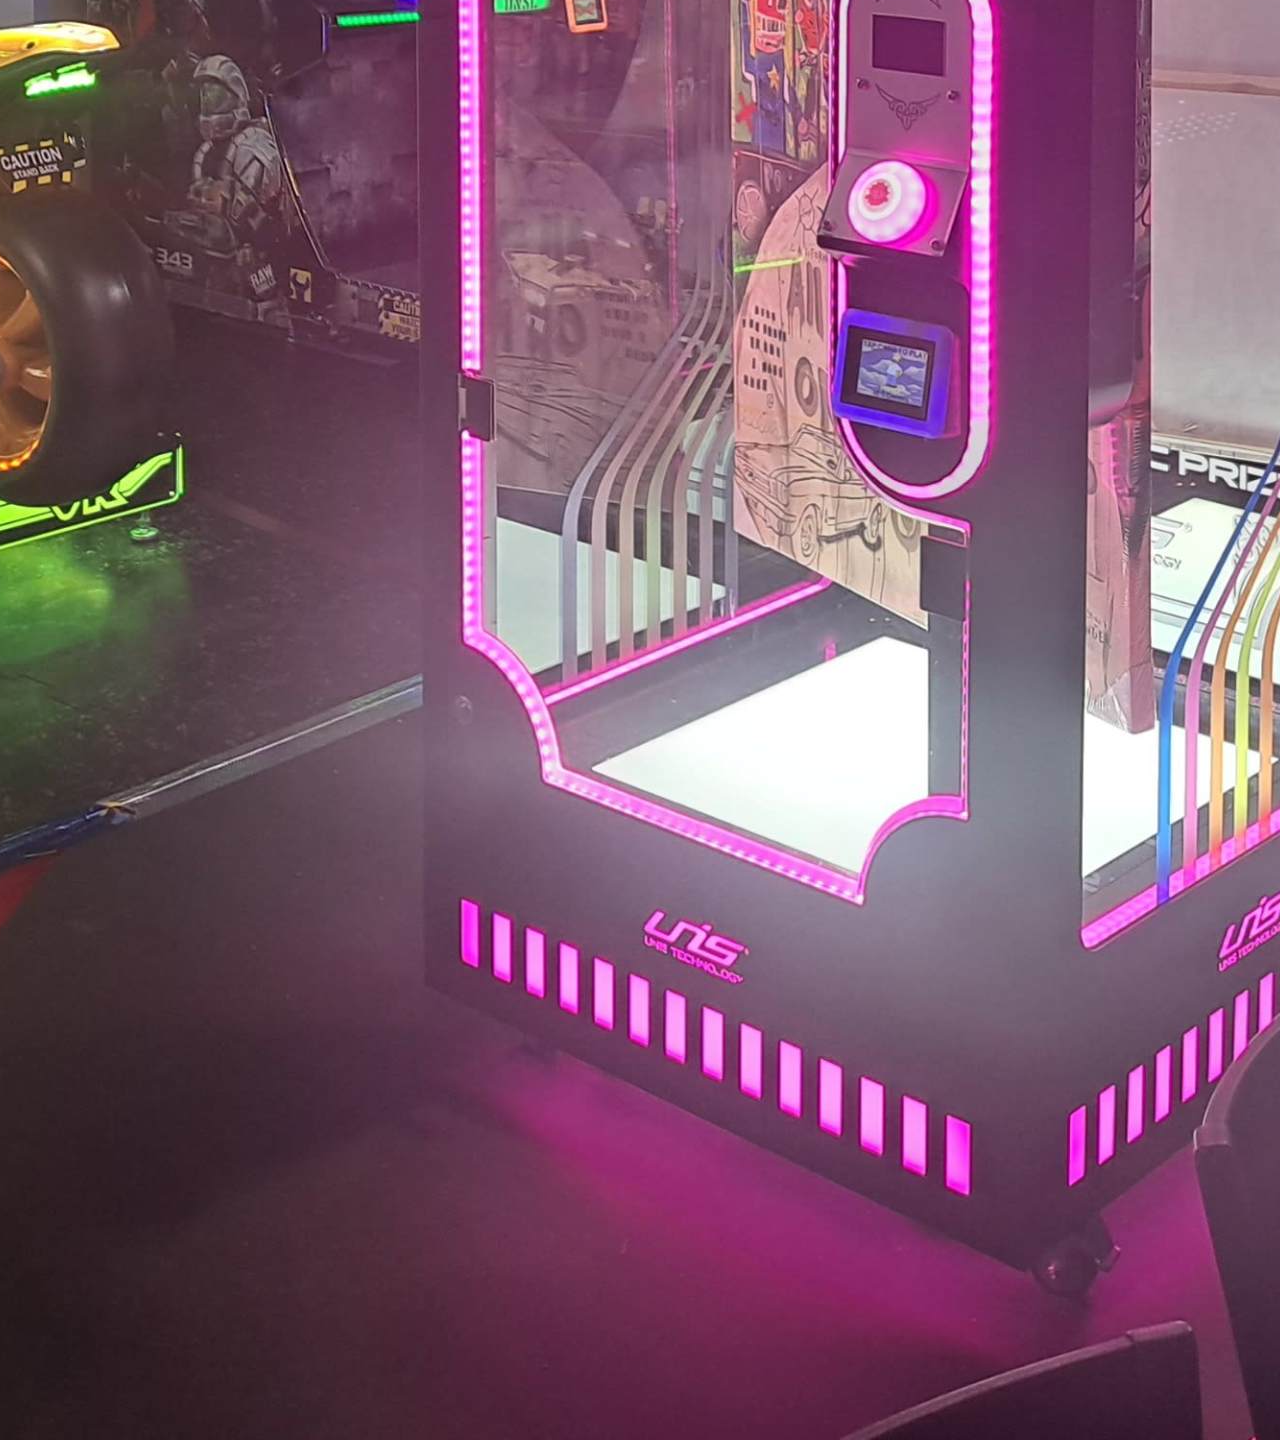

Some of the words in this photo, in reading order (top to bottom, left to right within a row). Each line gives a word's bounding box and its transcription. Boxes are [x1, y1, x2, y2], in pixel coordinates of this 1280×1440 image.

[0, 146, 63, 171] CAUTION
[12, 166, 38, 181] STAND
[39, 162, 59, 175] BACK
[157, 246, 193, 271] 343
[669, 945, 744, 984] TECHNOLOGY
